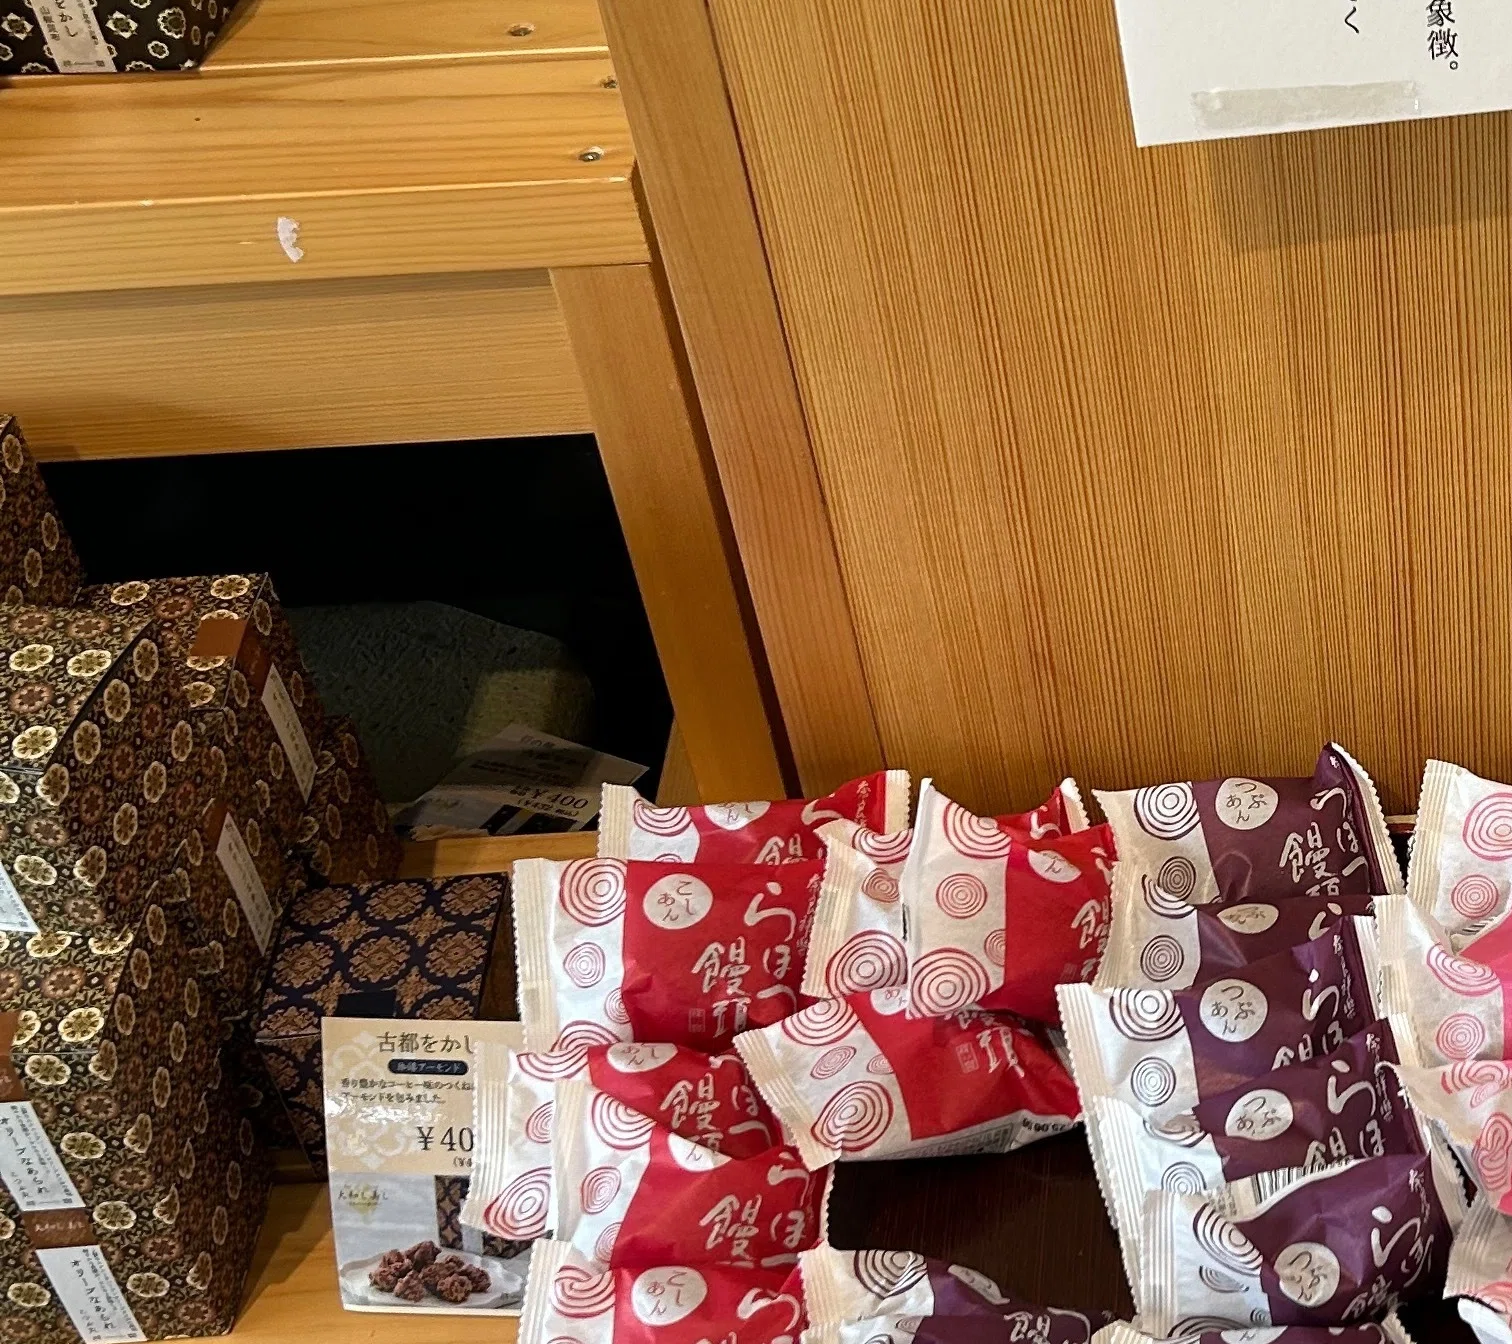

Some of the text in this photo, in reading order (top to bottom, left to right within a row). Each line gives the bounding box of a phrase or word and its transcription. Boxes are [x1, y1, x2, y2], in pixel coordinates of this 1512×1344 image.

[691, 936, 752, 1040] 饅頭
[376, 1030, 475, 1055] 古都をかし
